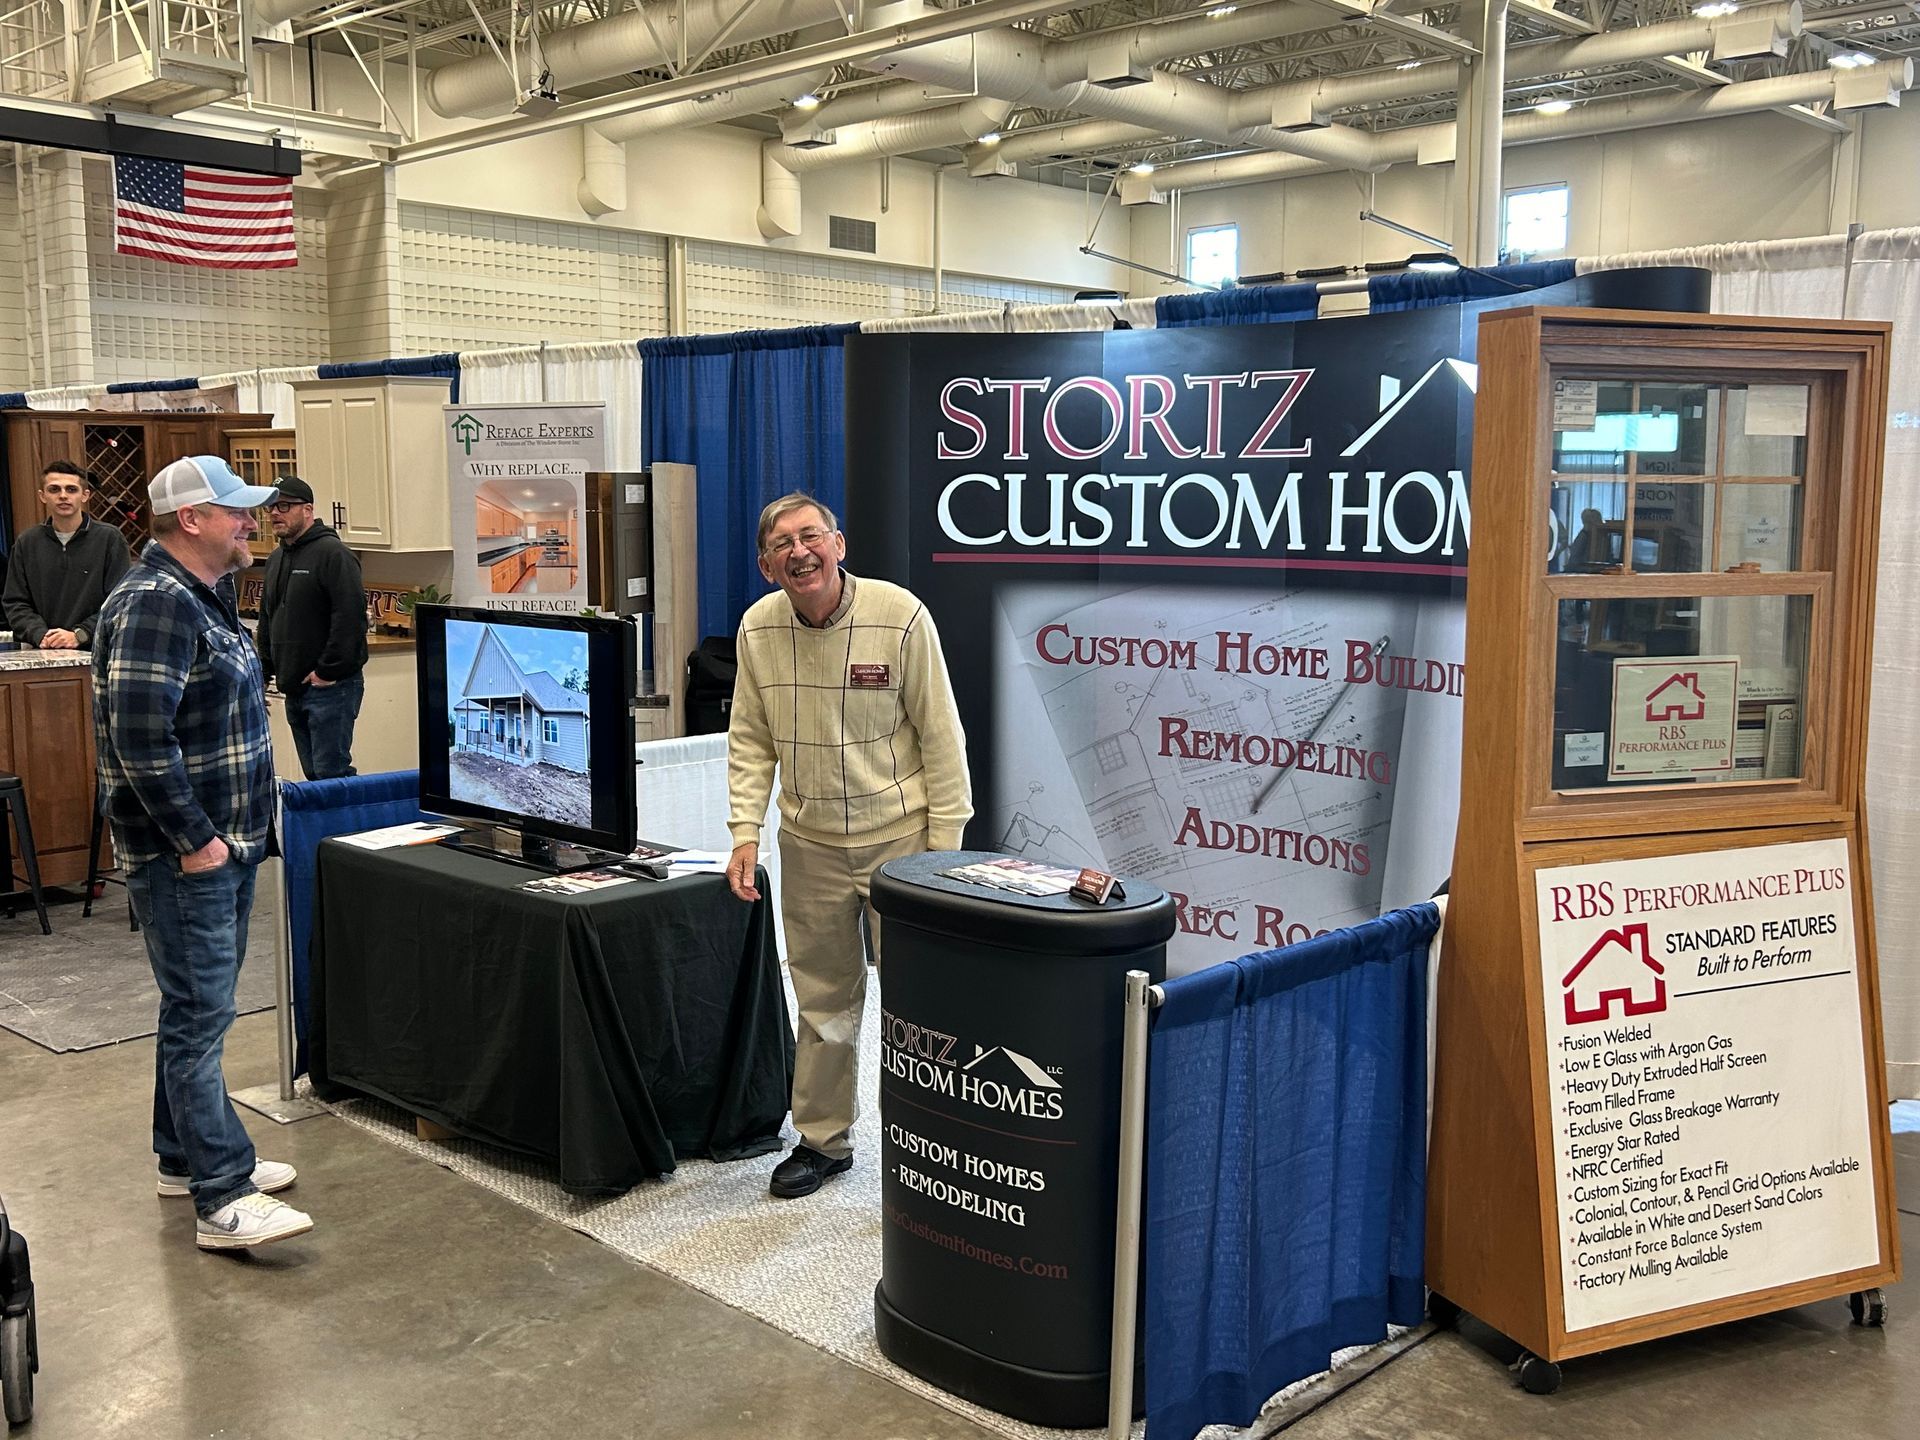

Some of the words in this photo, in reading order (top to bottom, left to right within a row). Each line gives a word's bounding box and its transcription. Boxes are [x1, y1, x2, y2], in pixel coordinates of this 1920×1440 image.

[486, 424, 533, 439] REFACE
[538, 423, 594, 438] EXPERTS
[938, 368, 1316, 460] STORTZ
[470, 463, 505, 476] WHY
[508, 462, 582, 476] REPLACE...
[937, 472, 1306, 550] CUSTOM
[364, 588, 409, 620] RTS
[522, 600, 576, 612] REFACE!
[1036, 622, 1198, 670] CUSTOM
[1215, 631, 1330, 680] HOME
[1158, 716, 1391, 785] REMODELING
[1619, 740, 1699, 753] PERFORMANCE
[1702, 738, 1727, 750] PLUS
[1659, 725, 1687, 741] RBS
[1174, 806, 1371, 876] ADDITIONS
[1550, 881, 1614, 922] RBS
[1622, 873, 1790, 914] PERFORMANCE
[1794, 867, 1845, 893] PLUS
[1168, 891, 1239, 941] REC
[1253, 904, 1331, 948] RO
[1665, 925, 1755, 954] STANDARD
[1762, 914, 1837, 941] FEATURES
[1697, 953, 1730, 976] Built
[1733, 953, 1748, 971] to
[1752, 946, 1812, 969] Perform
[1564, 1034, 1601, 1051] Fusion
[1604, 1023, 1651, 1045] Welded
[1565, 1058, 1590, 1073] Low
[1593, 1054, 1601, 1068] E
[1604, 1049, 1637, 1067] Glass
[1640, 1043, 1665, 1060] with
[1668, 1042, 1705, 1058] Argon
[1708, 1035, 1732, 1050] Gas
[1047, 1066, 1064, 1075] LLC
[1567, 1079, 1608, 1094] Heavy
[1612, 1072, 1640, 1088] Duty
[1644, 1058, 1697, 1081] Extruded
[1701, 1055, 1724, 1072] Half
[1727, 1053, 1767, 1068] Screen
[961, 1073, 1063, 1119] HOMES
[1568, 1100, 1602, 1116] Foam
[1605, 1090, 1635, 1110] Filled
[1638, 1089, 1675, 1104] Frame
[1570, 1117, 1622, 1138] Exclusive
[1630, 1110, 1662, 1127] Glass
[1665, 1101, 1722, 1121] Breakage
[1725, 1091, 1780, 1110] Warranty
[890, 1123, 958, 1170] CUSTOM
[964, 1153, 1046, 1191] HOMES
[1571, 1143, 1614, 1159] Energy
[1617, 1135, 1641, 1151] Star
[1644, 1125, 1680, 1146] Rated
[1572, 1160, 1608, 1181] NFRC
[1610, 1149, 1663, 1173] Certified
[1574, 1185, 1619, 1202] Custom
[1622, 1176, 1658, 1193] Sizing
[1660, 1170, 1677, 1186] for
[1680, 1164, 1712, 1182] Exact
[1715, 1160, 1728, 1176] Fit
[899, 1164, 1025, 1227] REMODELING
[1575, 1200, 1627, 1224] Colonial,
[1630, 1195, 1681, 1213] Contour,
[1683, 1187, 1695, 1203] &
[1697, 1179, 1730, 1200] Pencil
[1732, 1173, 1759, 1194] Grid
[1761, 1169, 1806, 1190] Options
[1809, 1156, 1859, 1179] Available
[1577, 1221, 1632, 1246] Available
[1635, 1220, 1646, 1234] in
[1648, 1213, 1685, 1231] White
[1688, 1203, 1710, 1224] and
[1713, 1199, 1751, 1218] Desert
[1754, 1190, 1785, 1210] Sand
[1786, 1185, 1823, 1203] Colors
[1578, 1245, 1632, 1267] Constant
[1635, 1240, 1667, 1256] Force
[1671, 1230, 1717, 1248] Balance
[1721, 1221, 1762, 1240] System
[1579, 1270, 1626, 1290] Factory
[1629, 1259, 1671, 1279] Mulling
[1675, 1245, 1728, 1269] Available
